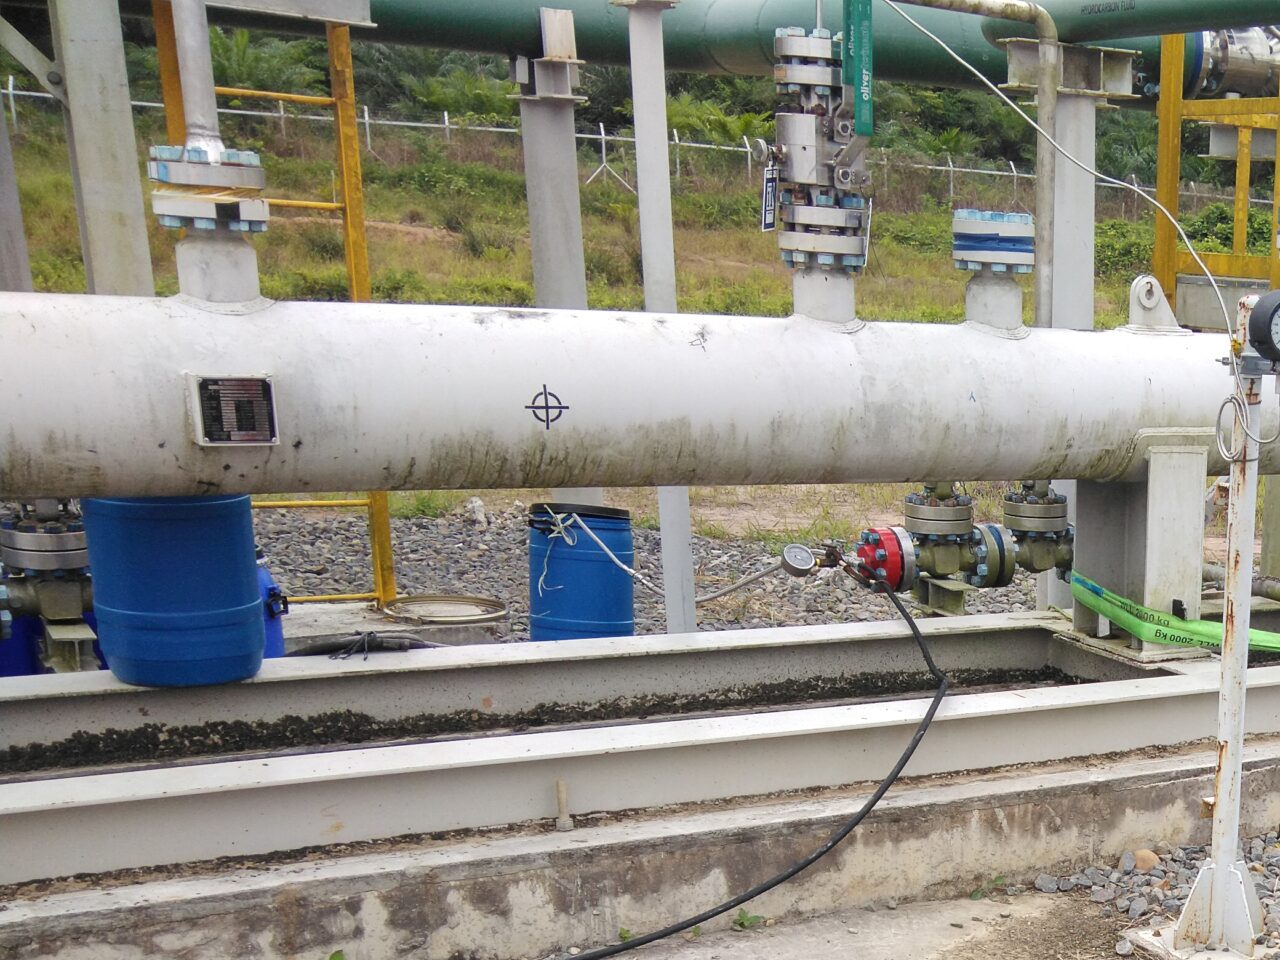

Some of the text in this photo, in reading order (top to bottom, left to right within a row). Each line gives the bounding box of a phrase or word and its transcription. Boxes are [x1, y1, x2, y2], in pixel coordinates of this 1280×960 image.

[861, 69, 870, 101] oliver
[1155, 628, 1168, 639] kg
[1169, 634, 1194, 645] 2000
